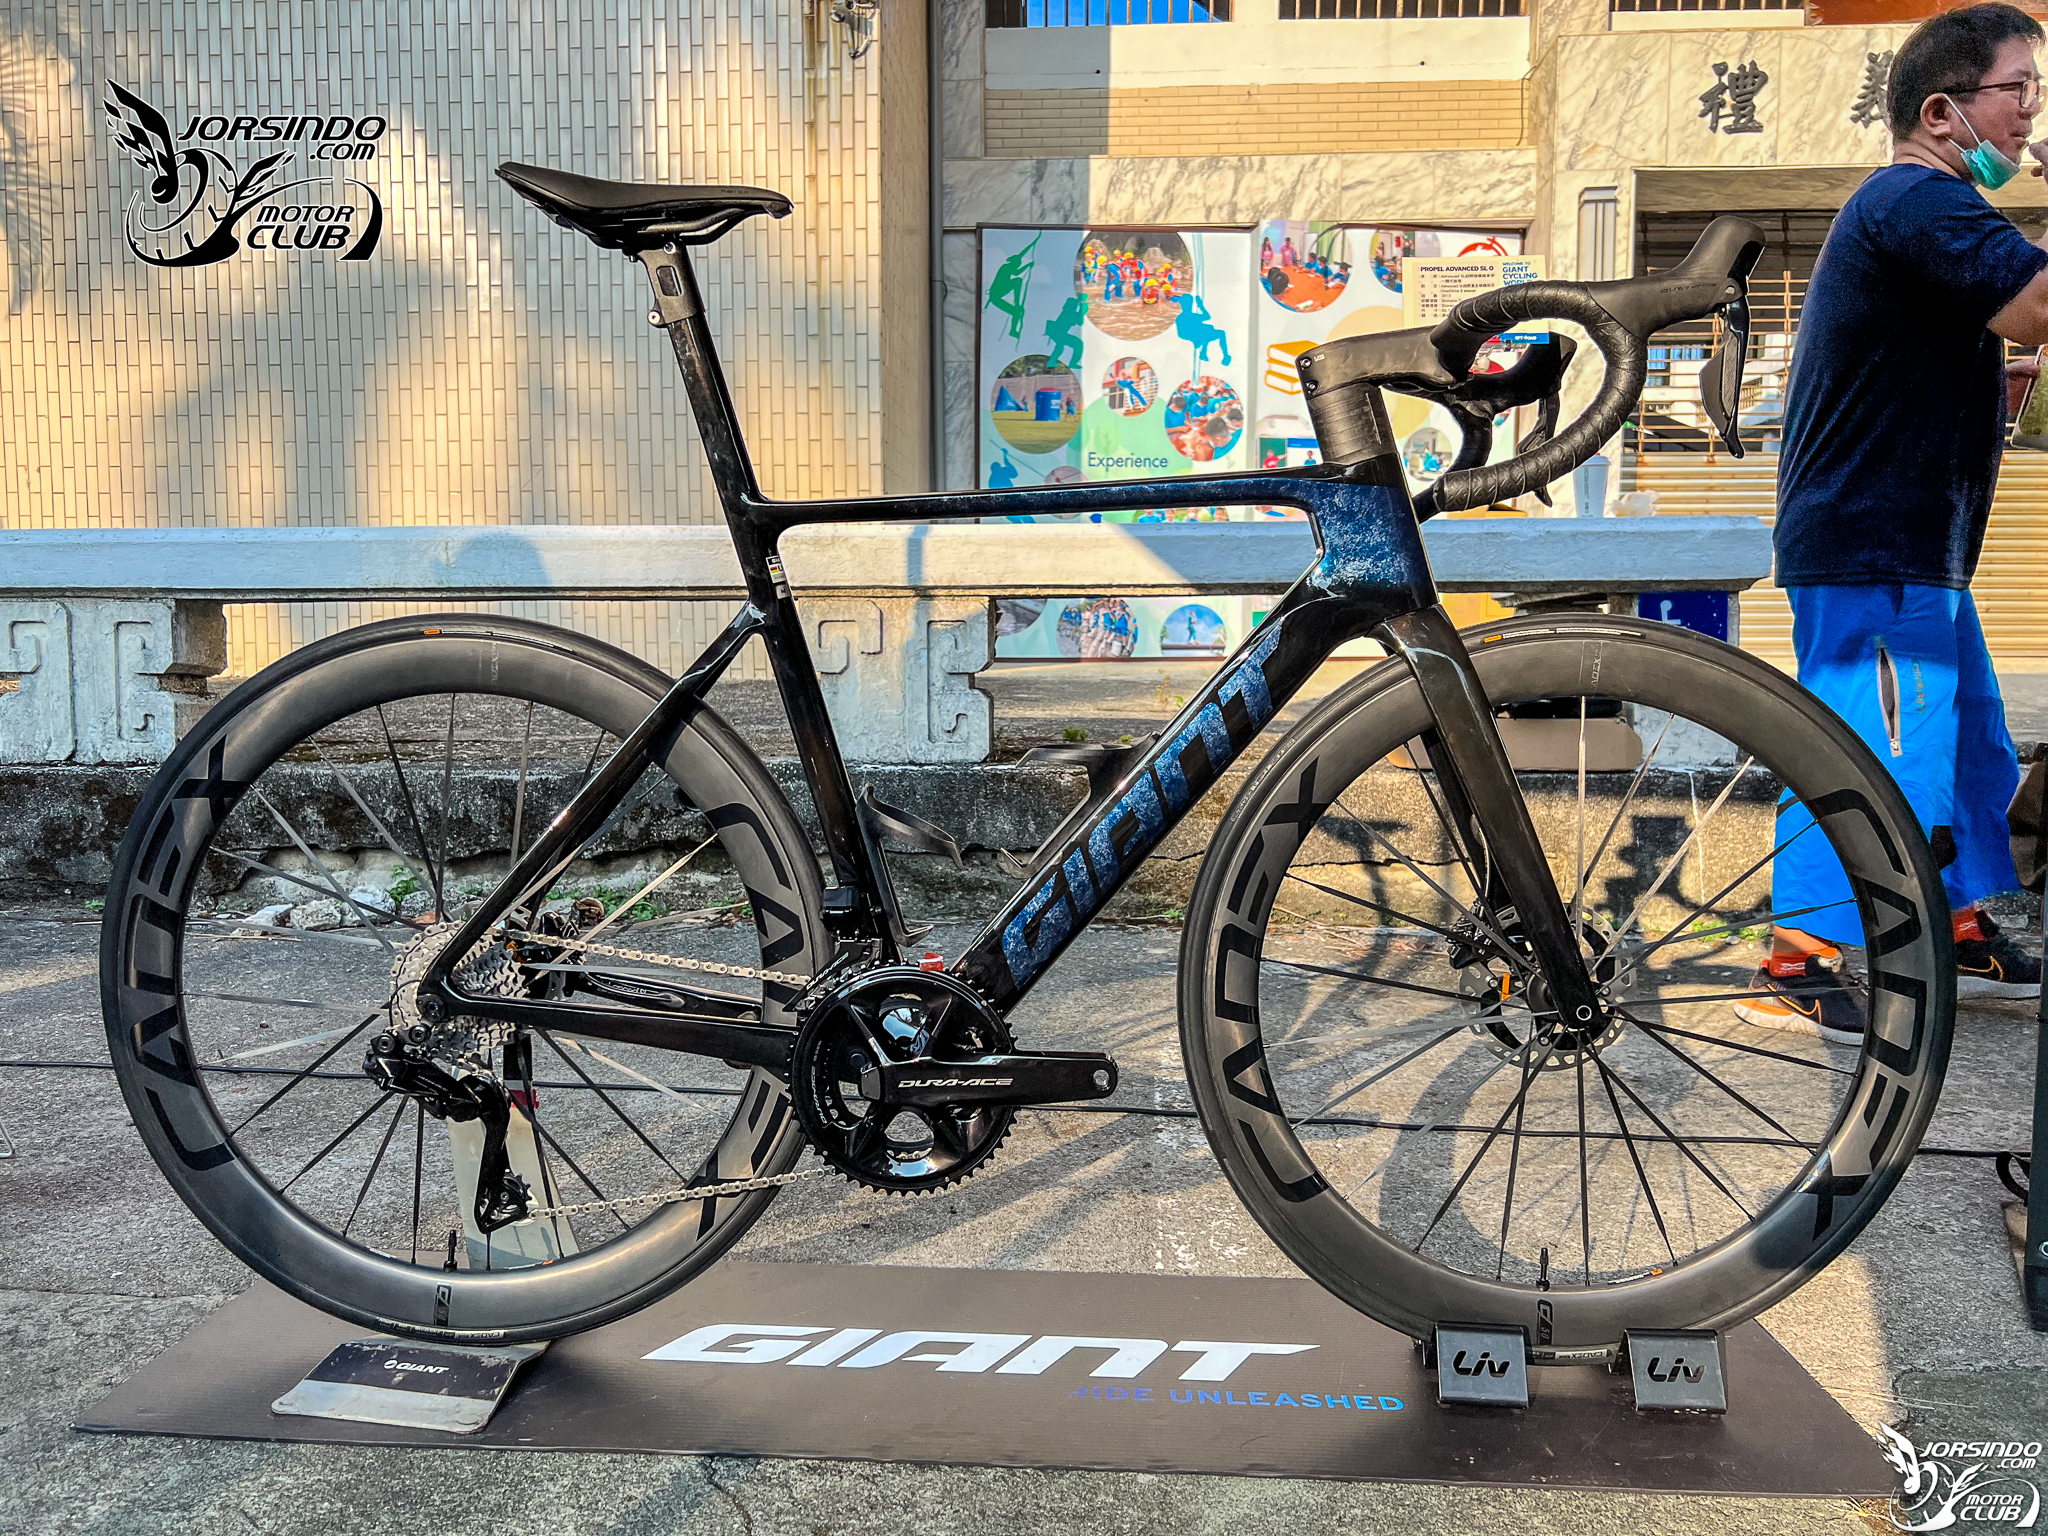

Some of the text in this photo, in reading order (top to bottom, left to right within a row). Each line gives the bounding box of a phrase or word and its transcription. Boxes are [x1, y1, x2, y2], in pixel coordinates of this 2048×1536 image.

[1502, 265, 1530, 273] GIANT
[1502, 272, 1539, 280] CYCLING
[1088, 451, 1169, 473] Experience
[1912, 661, 1926, 714] GIANT
[1001, 618, 1284, 991] GIANT
[124, 733, 252, 1172] CADEX
[1214, 755, 1332, 1203] CADEX
[1799, 787, 1928, 1241] CADEX
[897, 1078, 1014, 1089] DURA-ACE
[639, 1322, 1322, 1382] GIANT
[1452, 1350, 1511, 1378] Liv
[396, 1361, 450, 1375] GIANT
[1646, 1356, 1707, 1384] Liv
[1169, 1388, 1405, 1412] UNLEASHED
